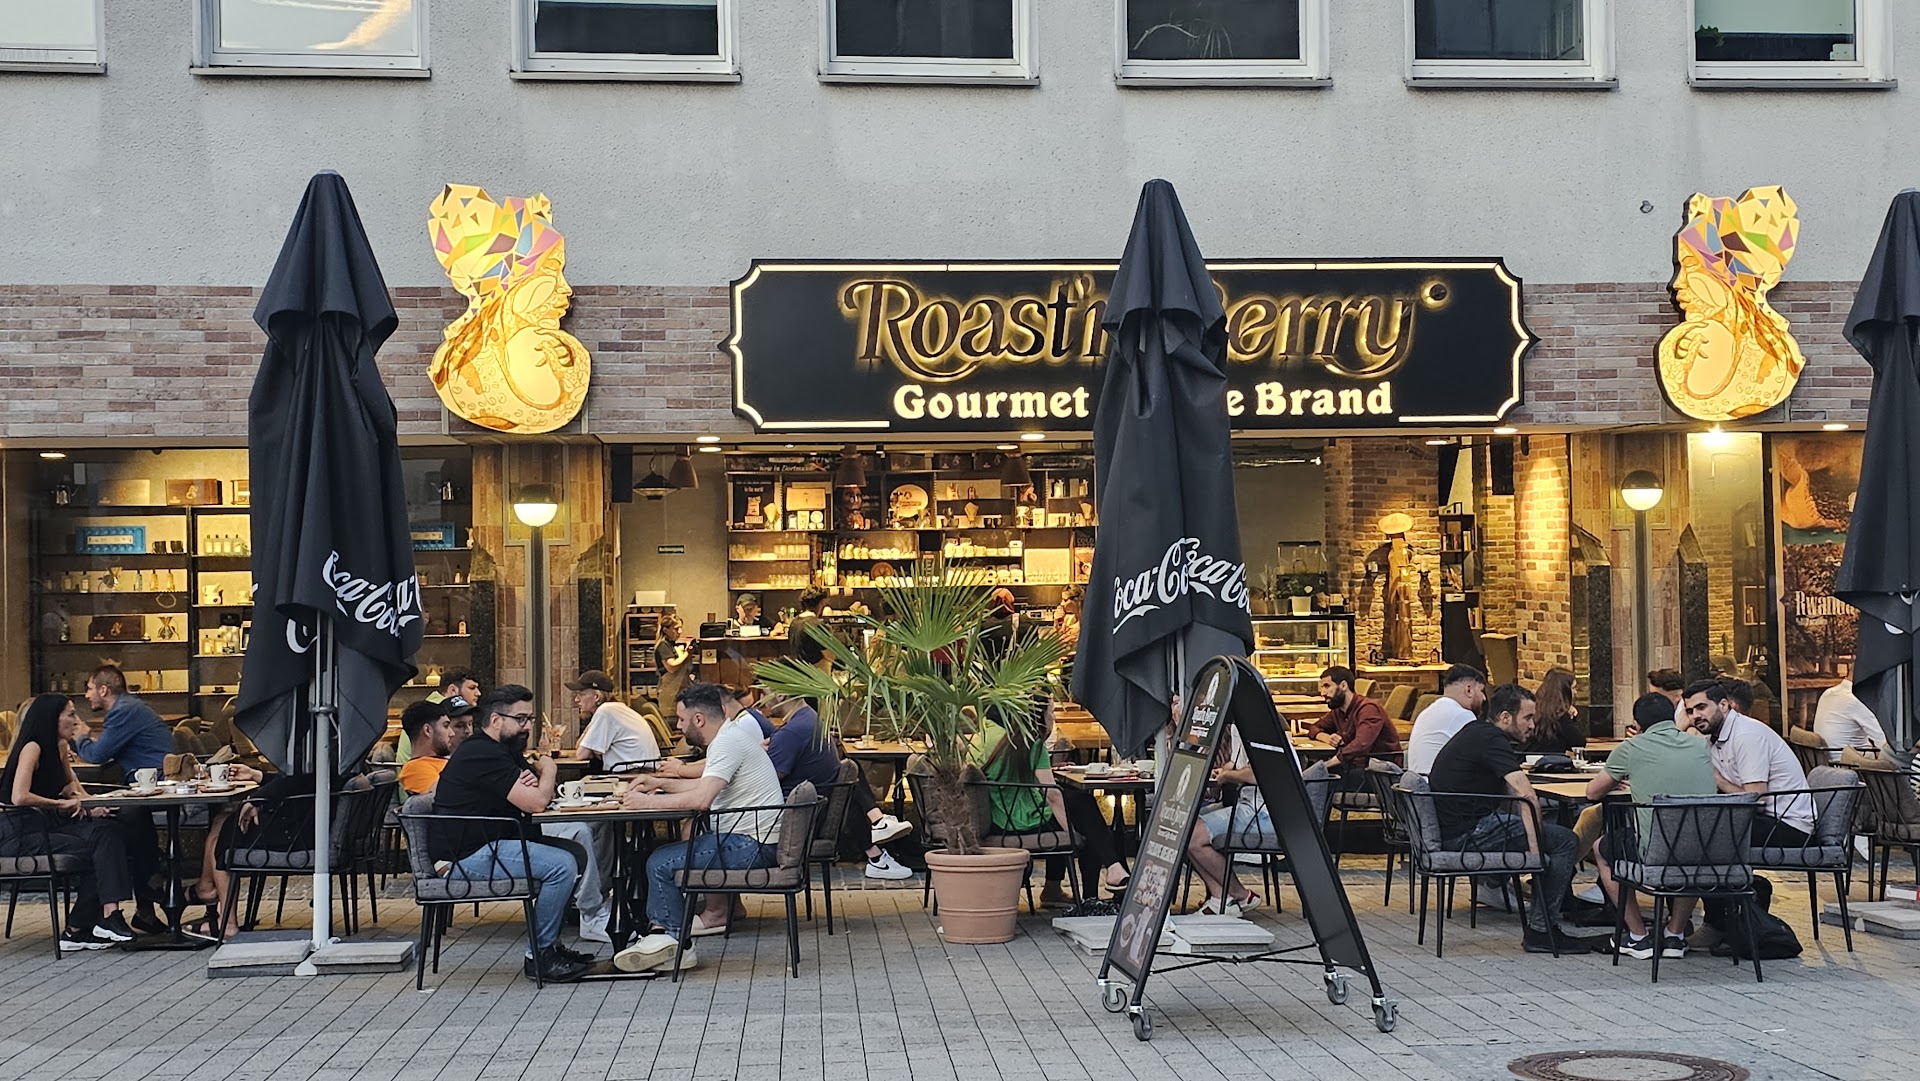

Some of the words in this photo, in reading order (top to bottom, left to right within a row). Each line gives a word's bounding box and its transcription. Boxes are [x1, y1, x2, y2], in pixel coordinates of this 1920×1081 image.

[1213, 283, 1413, 376] erry
[893, 384, 1090, 419] Gourmet
[1255, 381, 1393, 416] Brand
